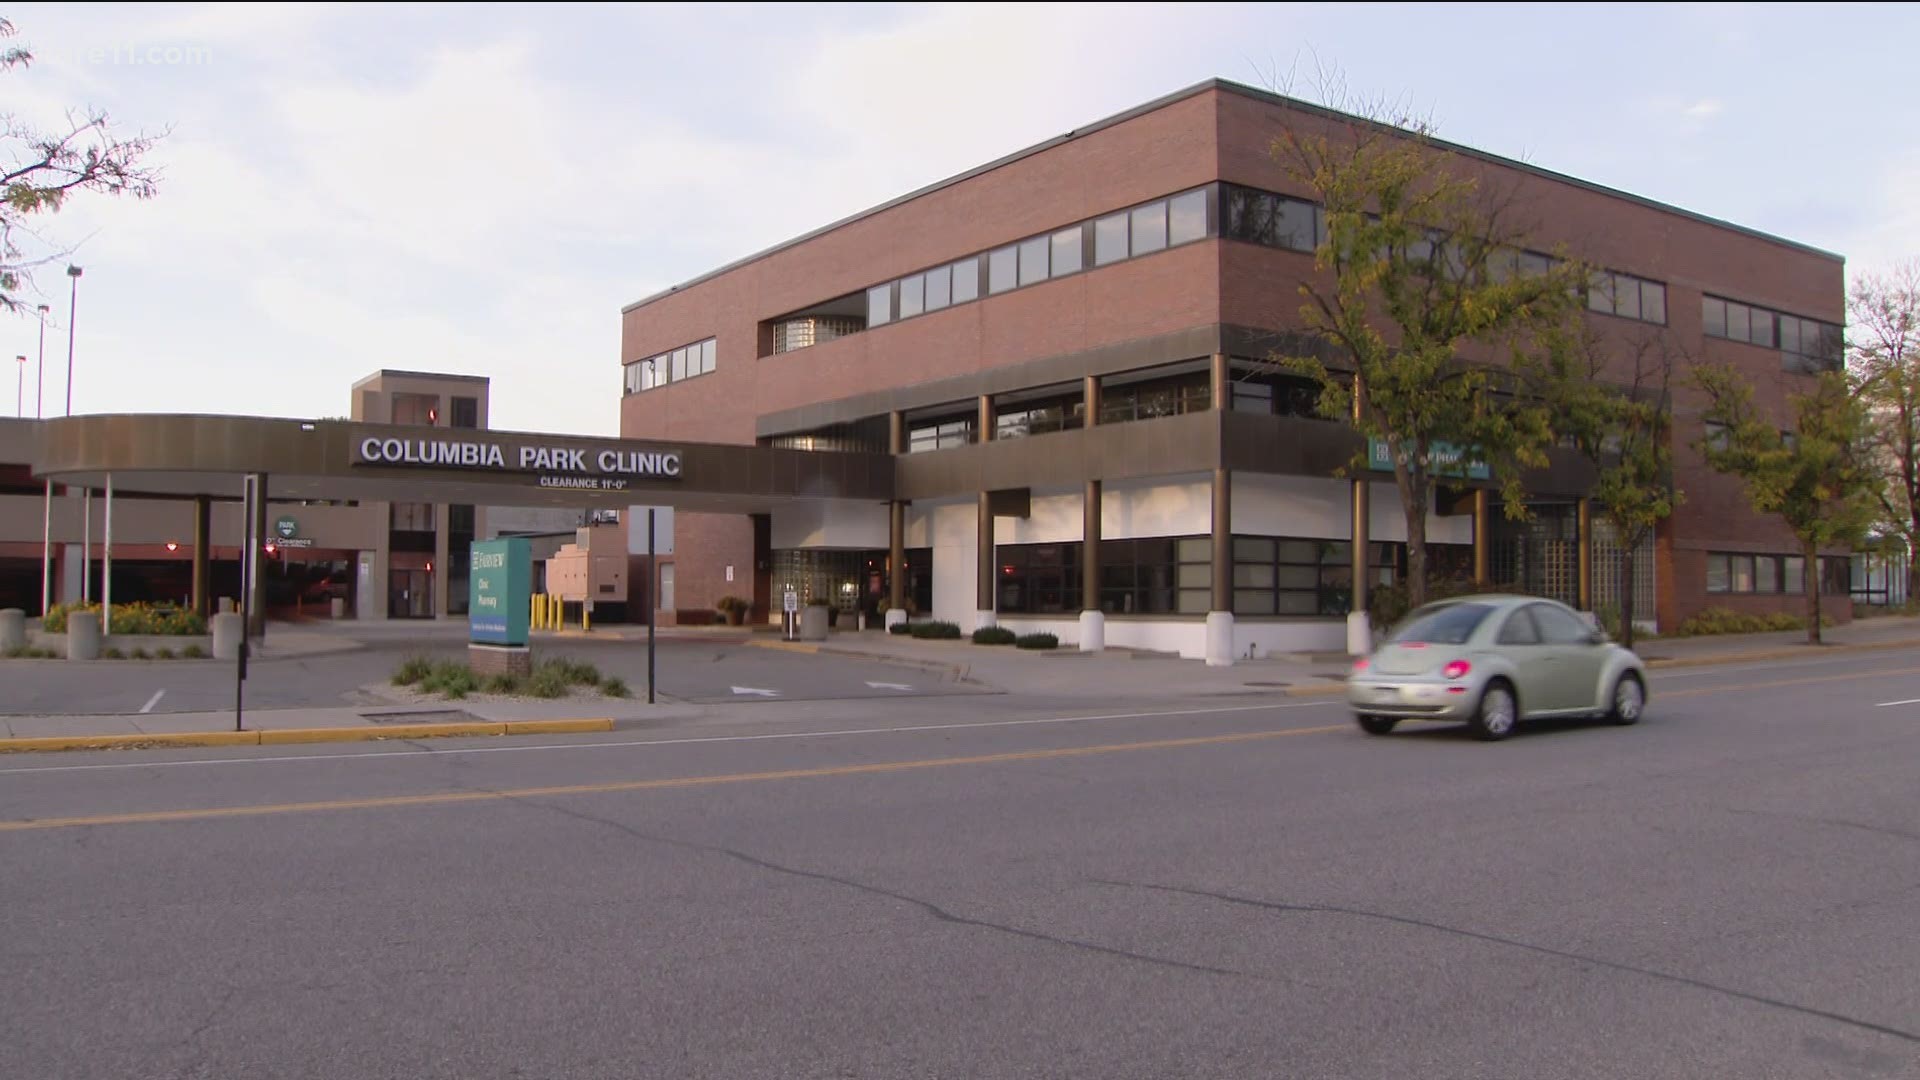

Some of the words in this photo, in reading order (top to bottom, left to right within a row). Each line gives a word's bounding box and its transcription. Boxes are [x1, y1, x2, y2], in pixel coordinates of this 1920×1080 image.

[361, 437, 505, 467] COLUMBIA
[519, 446, 587, 471] PARK
[598, 450, 680, 475] CLINIC
[540, 476, 598, 489] CLEARANCE
